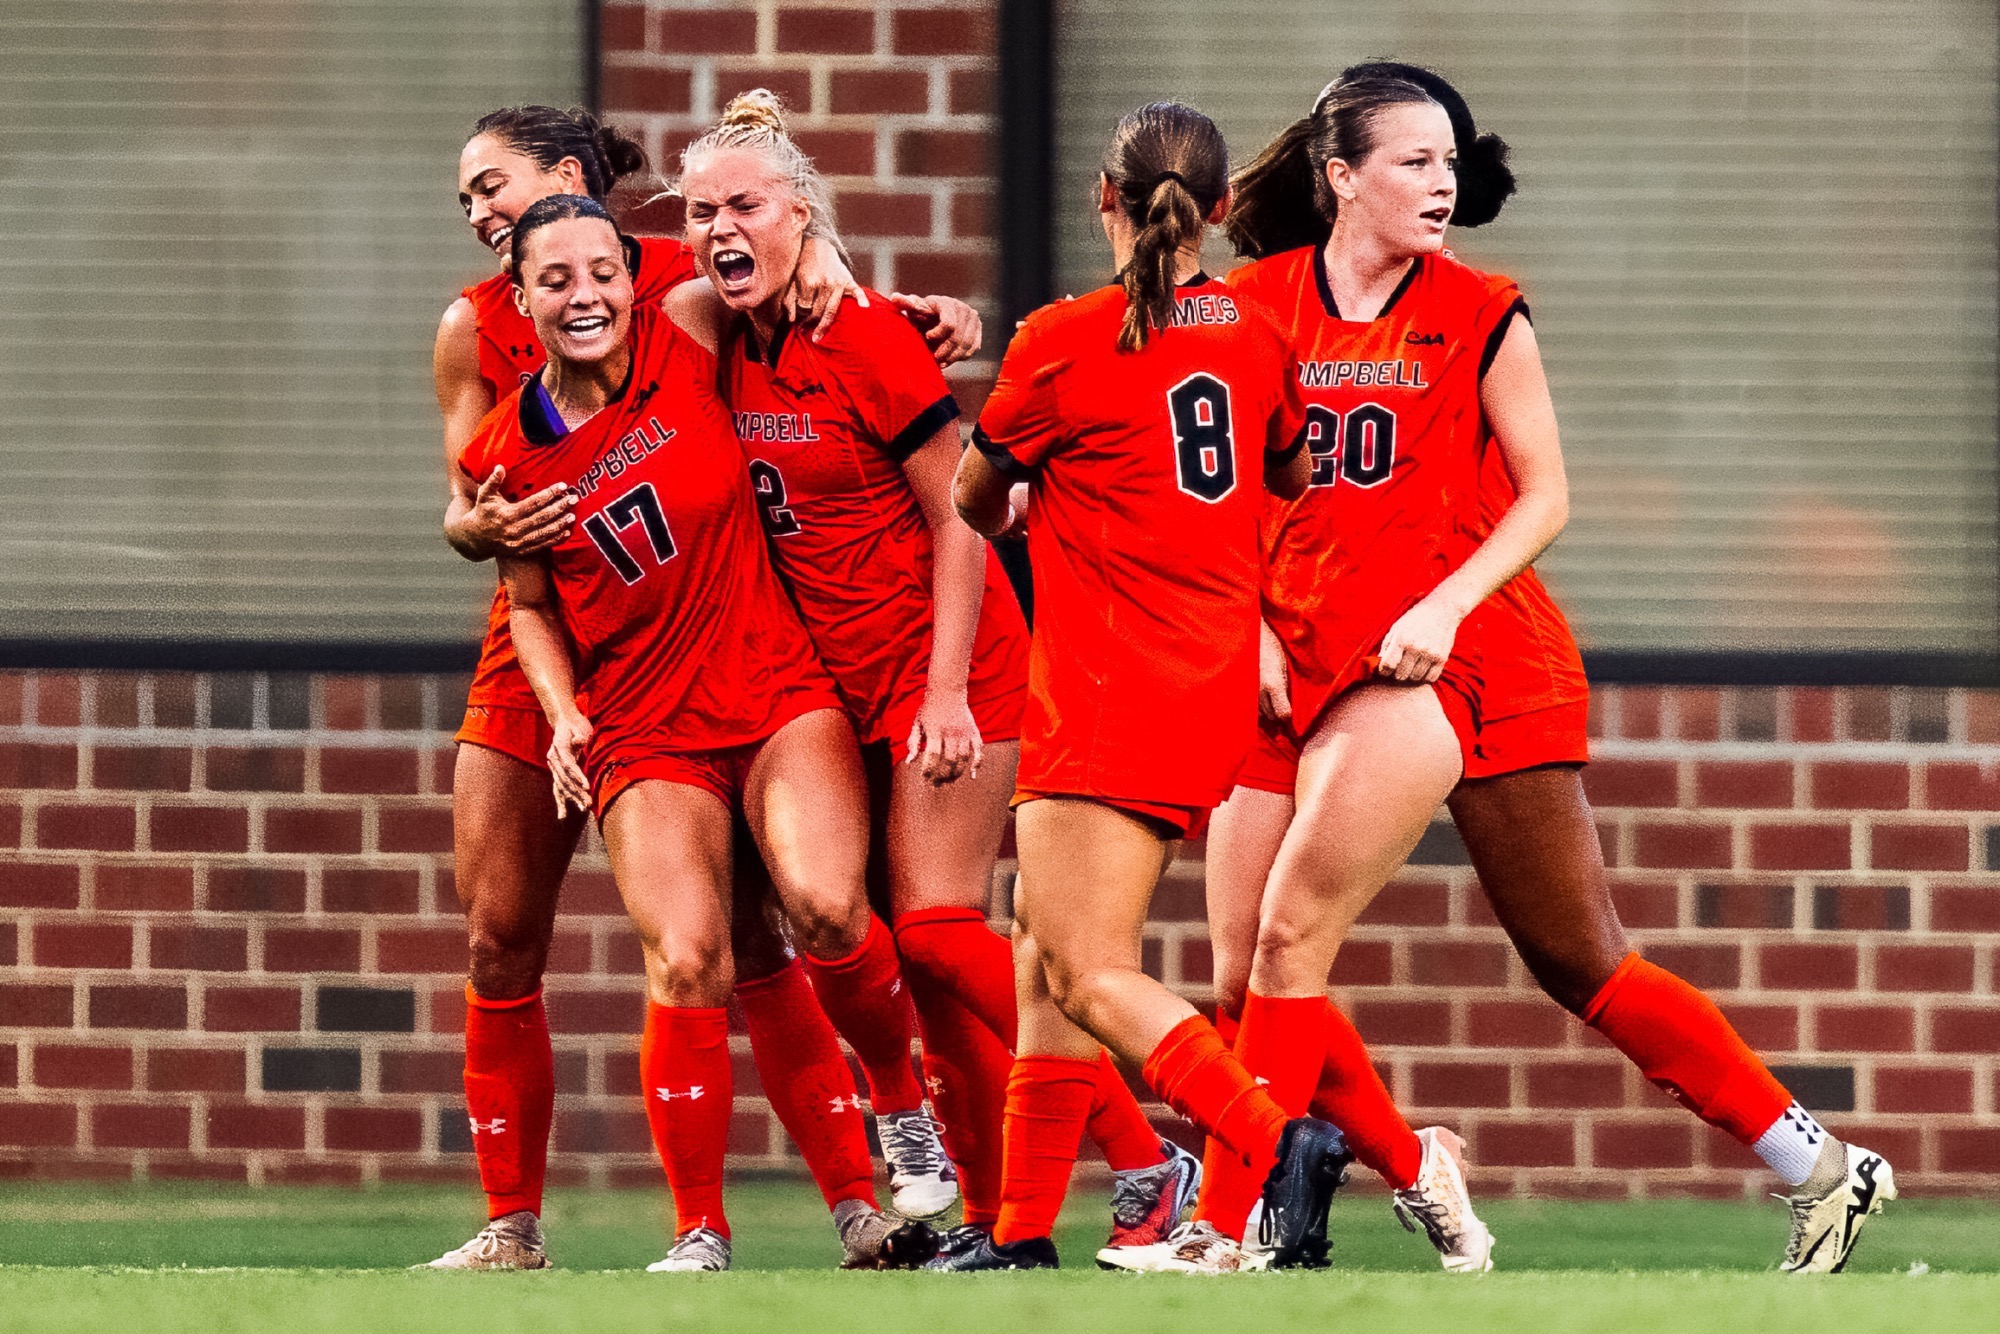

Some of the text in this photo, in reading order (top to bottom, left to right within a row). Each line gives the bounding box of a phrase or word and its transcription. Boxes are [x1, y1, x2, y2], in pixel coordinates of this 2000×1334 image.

[1148, 294, 1239, 328] MELS
[1166, 371, 1237, 504] 8
[1306, 402, 1397, 488] 20
[581, 481, 678, 586] 17
